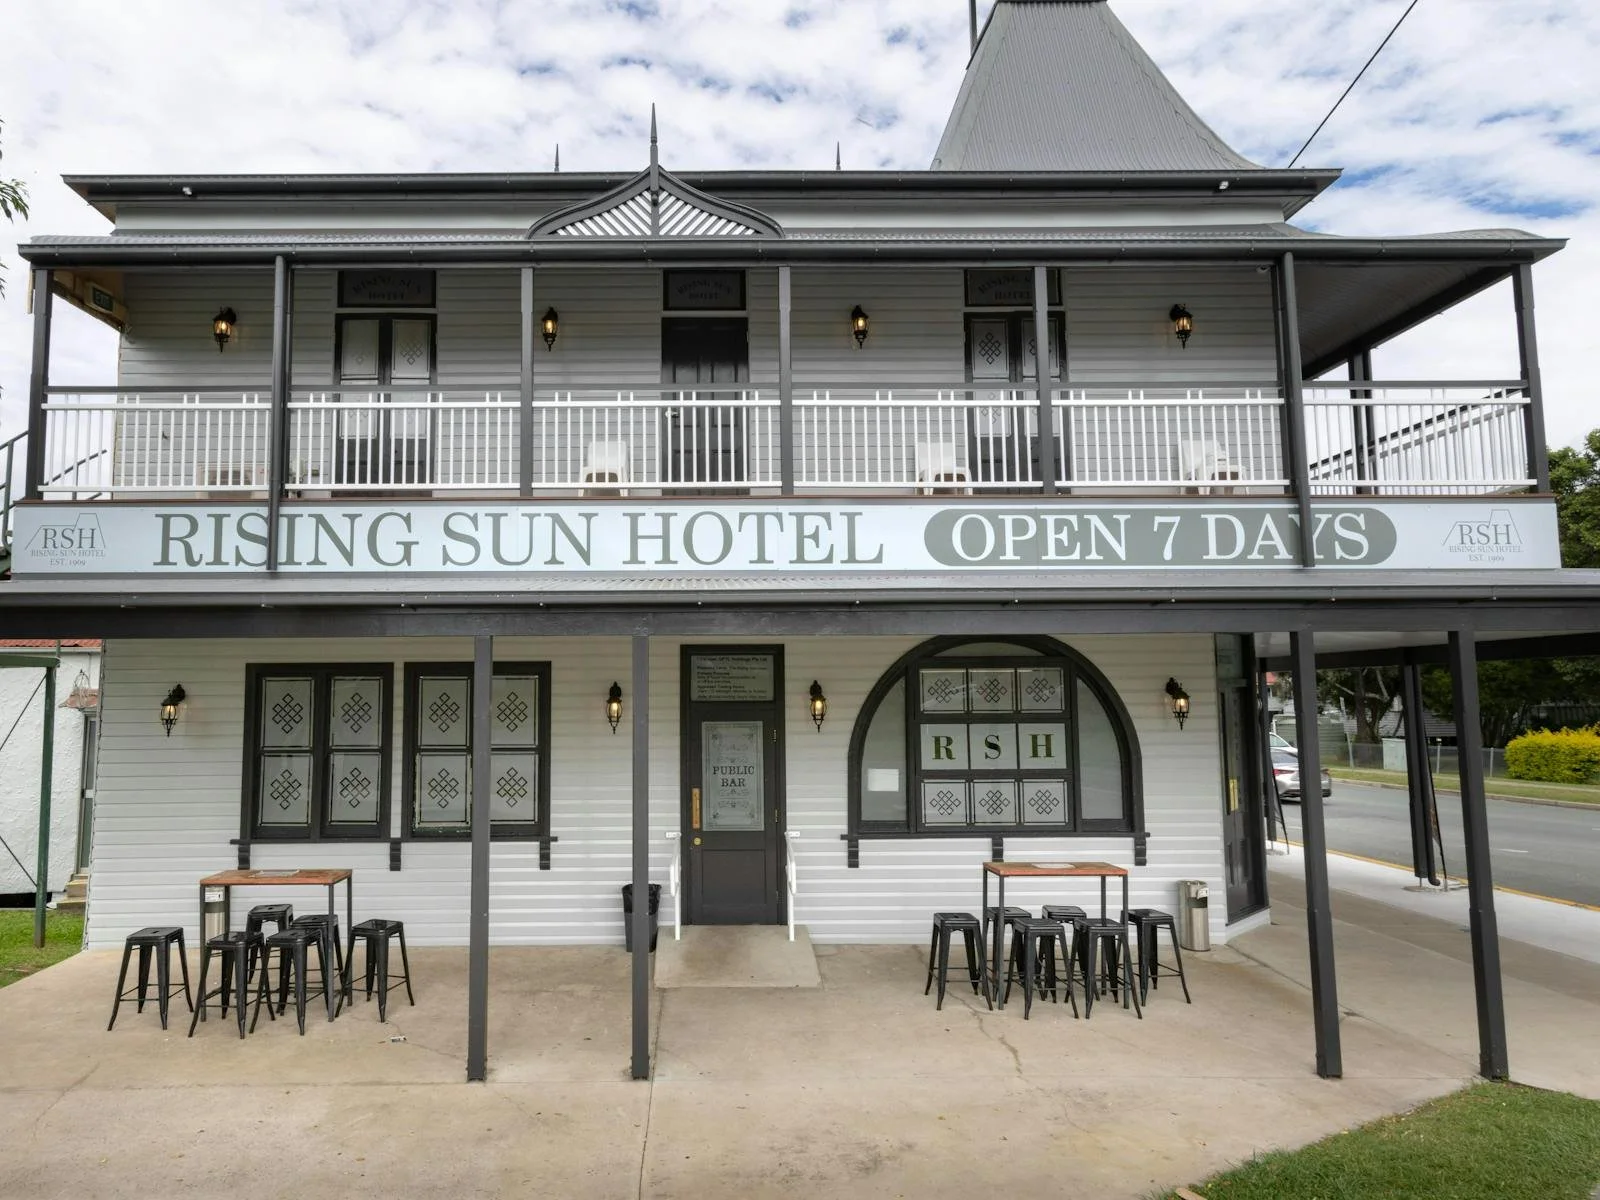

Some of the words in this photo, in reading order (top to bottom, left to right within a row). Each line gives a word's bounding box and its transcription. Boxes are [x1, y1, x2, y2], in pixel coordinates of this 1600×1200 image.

[42, 528, 97, 549] RSH
[153, 511, 419, 567] RISING
[442, 511, 598, 567] SUN
[622, 510, 884, 566] HOTEL
[951, 512, 1131, 561] OPEN
[1152, 515, 1181, 561] 7
[1200, 511, 1370, 561] DAYS
[1458, 523, 1511, 545] RSH
[31, 549, 58, 557] RISING
[60, 549, 76, 557] SUN
[77, 549, 105, 557] HOTEL
[1449, 545, 1475, 553] RISING
[1477, 545, 1494, 553] SUN
[1496, 545, 1524, 553] HOTEL
[932, 735, 956, 760] R
[984, 734, 1001, 760] S
[1029, 733, 1056, 759] H
[713, 766, 755, 775] PUBLIC
[721, 778, 745, 787] BAR
